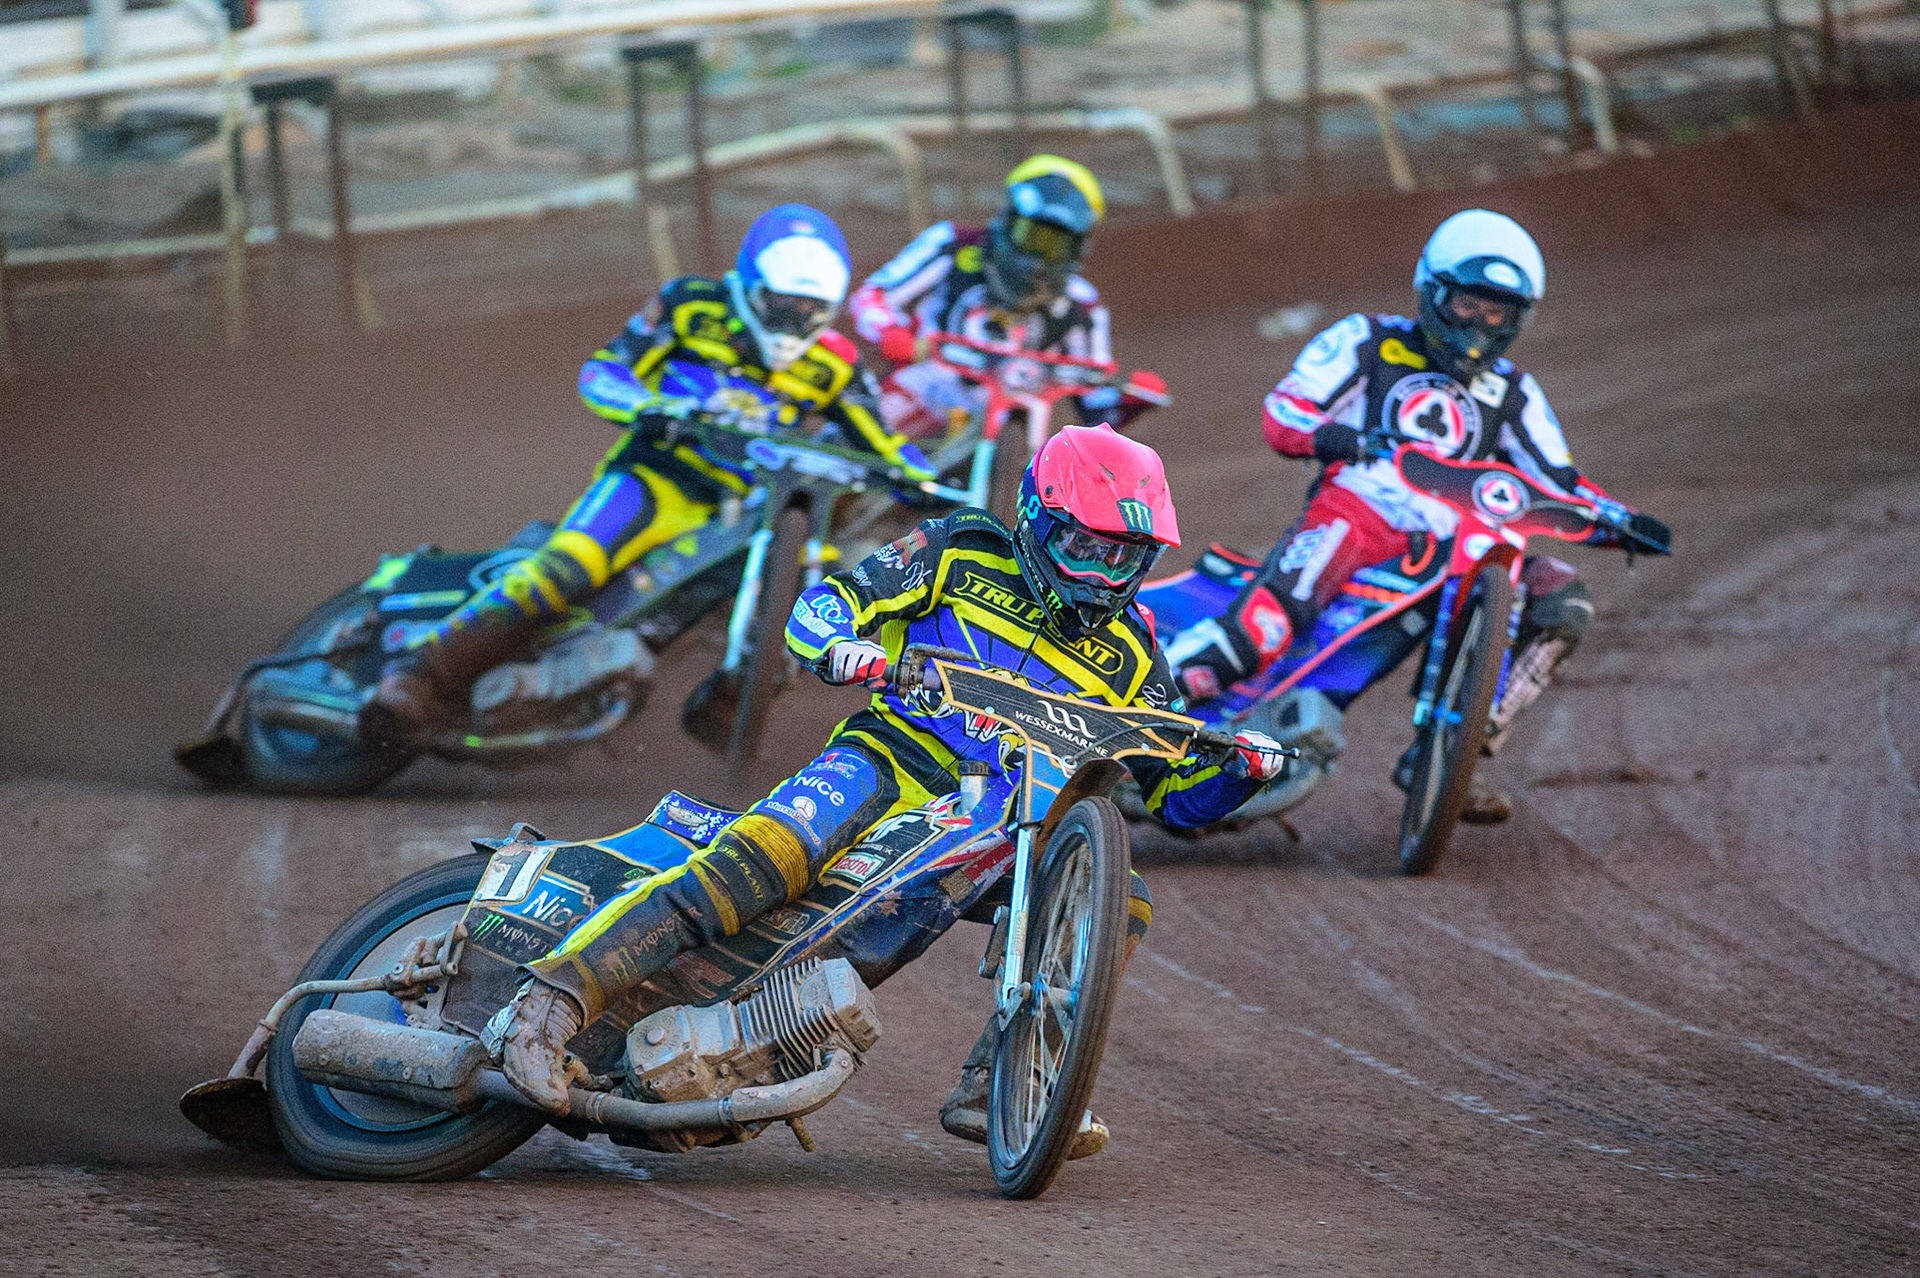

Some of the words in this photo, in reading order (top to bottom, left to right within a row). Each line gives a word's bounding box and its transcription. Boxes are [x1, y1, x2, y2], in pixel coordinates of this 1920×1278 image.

[968, 579, 1026, 614] TRU
[1014, 710, 1109, 758] WESSEXMARINE
[793, 776, 845, 807] Nice
[494, 850, 532, 897] 1
[632, 905, 704, 956] MONSTR
